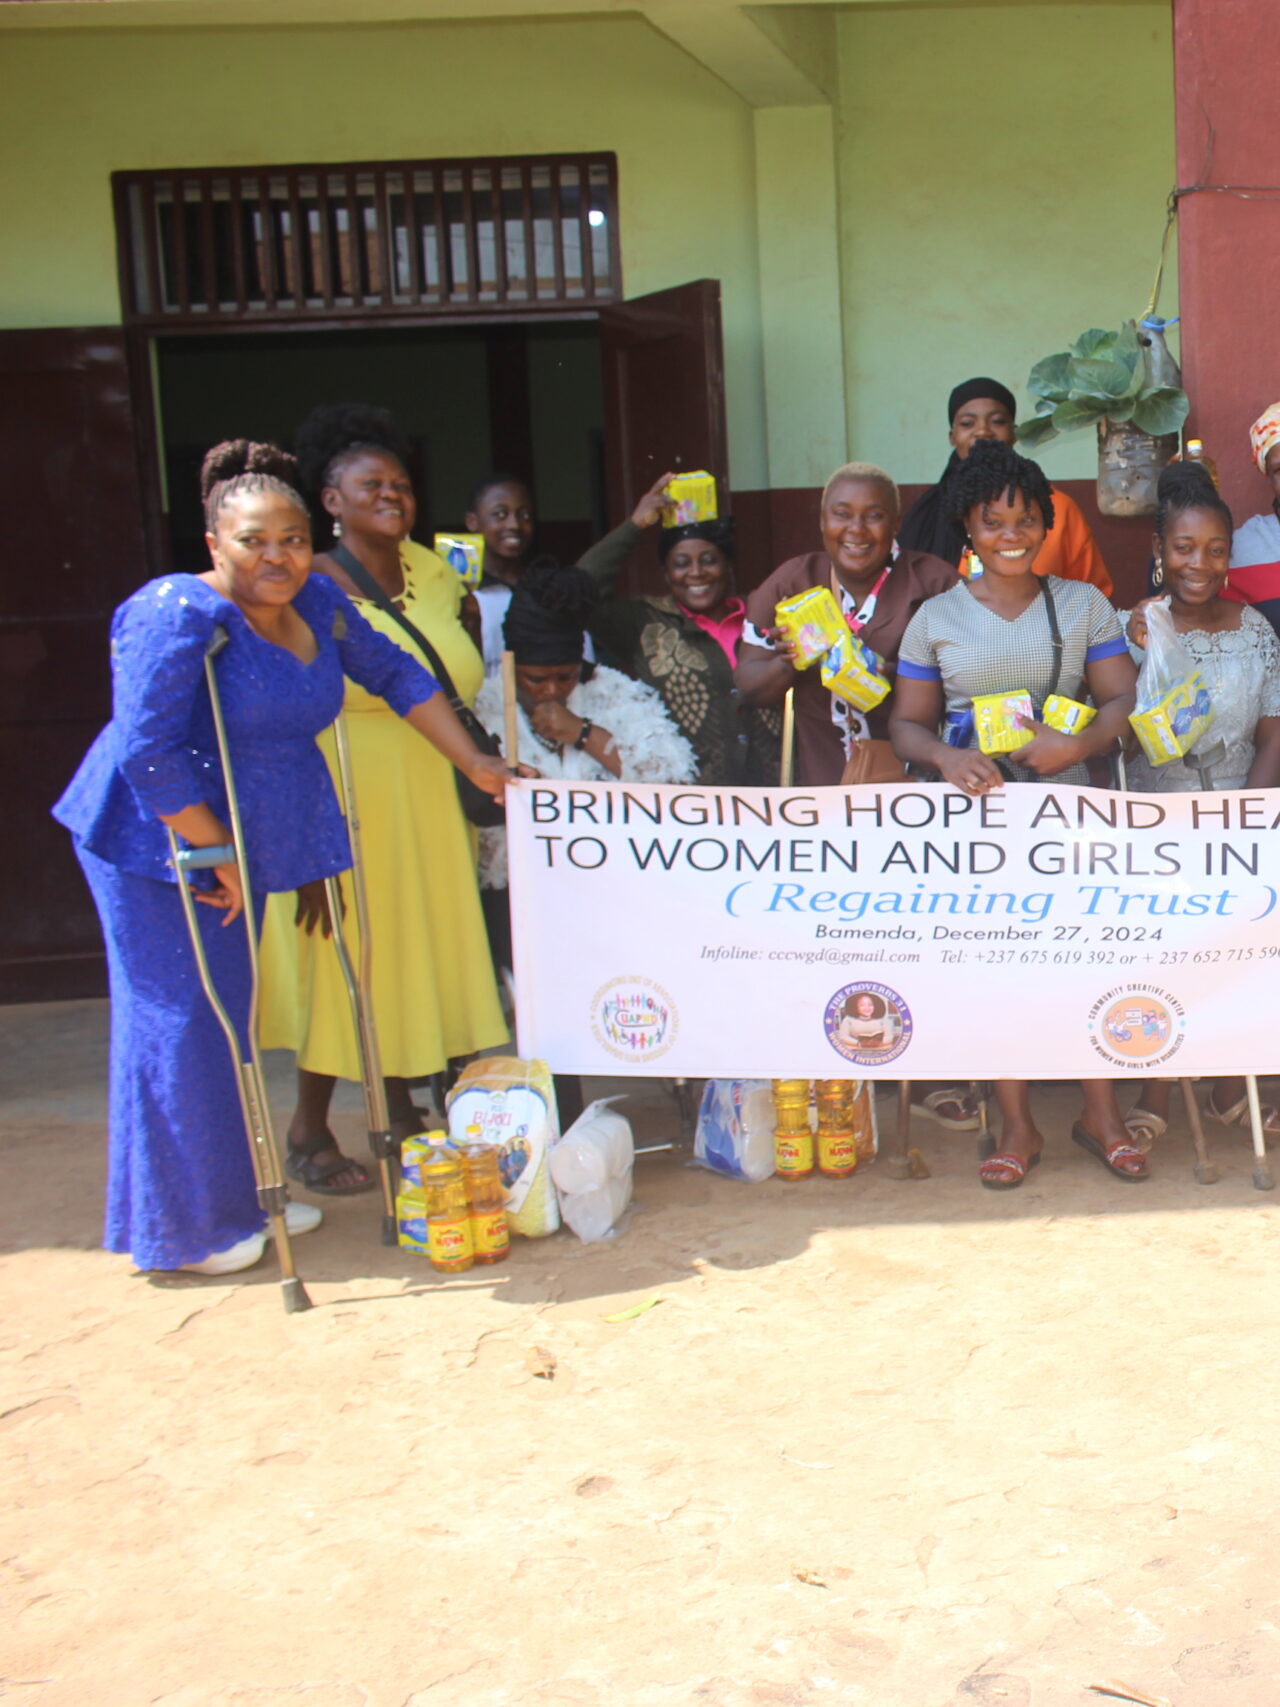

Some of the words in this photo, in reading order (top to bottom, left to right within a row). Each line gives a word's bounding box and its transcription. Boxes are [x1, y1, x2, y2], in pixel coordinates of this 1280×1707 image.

[531, 788, 820, 828] BRINGING
[845, 793, 1007, 829] HOPE
[1030, 793, 1166, 830] AND
[535, 836, 607, 870] TO
[628, 838, 858, 873] WOMEN
[880, 841, 1006, 875] AND
[1028, 841, 1181, 876] GIRLS
[1206, 843, 1259, 876] IN
[764, 883, 1055, 922] Regaining
[1078, 886, 1239, 917] Trust
[815, 924, 923, 943] Bamenda,
[933, 926, 1043, 942] December
[1053, 926, 1089, 943] 27,
[1101, 926, 1163, 943] 2024
[700, 945, 763, 961] Infoline:
[768, 948, 921, 965] cccwgd@gmail.com
[940, 949, 967, 964] Tel:
[975, 950, 1017, 965] +237
[1020, 951, 1048, 964] 675
[1053, 951, 1082, 964] 619
[1086, 951, 1115, 965] 392
[1119, 954, 1138, 965] or
[1159, 951, 1190, 965] 237
[1193, 950, 1222, 964] 652
[1227, 947, 1254, 961] 715
[829, 991, 845, 1010] THE
[844, 983, 898, 1001] PROVERBS
[1088, 986, 1124, 1019] COMMUNITY
[1127, 983, 1164, 996] CREATIVE
[1164, 993, 1185, 1016] CENTER
